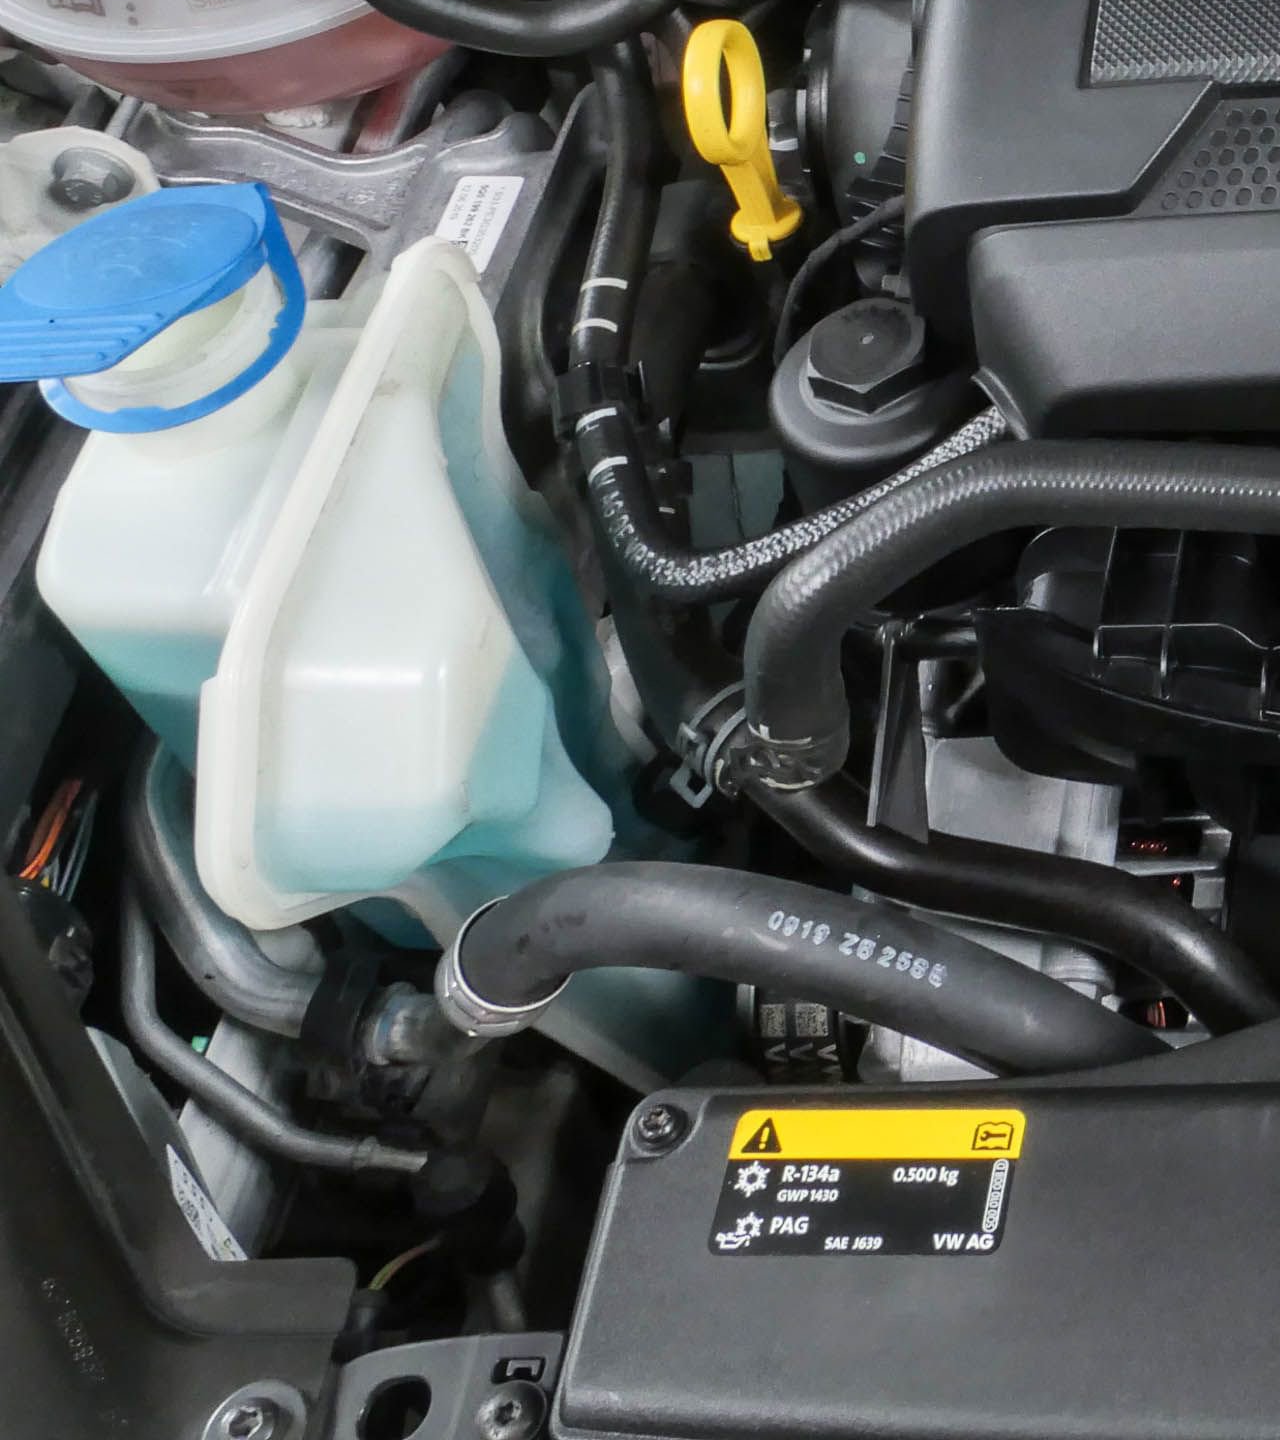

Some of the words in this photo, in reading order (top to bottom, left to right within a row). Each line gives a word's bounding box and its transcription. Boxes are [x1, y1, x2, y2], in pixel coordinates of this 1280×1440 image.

[781, 1164, 840, 1182] R-134a
[892, 1166, 938, 1182] 0.500
[937, 1165, 959, 1186] kg
[776, 1188, 809, 1202] GWP
[809, 1188, 839, 1202] 1430
[768, 1215, 809, 1234] PAG
[823, 1236, 849, 1250] SAE
[851, 1236, 882, 1250] J639
[932, 1232, 965, 1250] VW
[964, 1232, 994, 1250] AG
